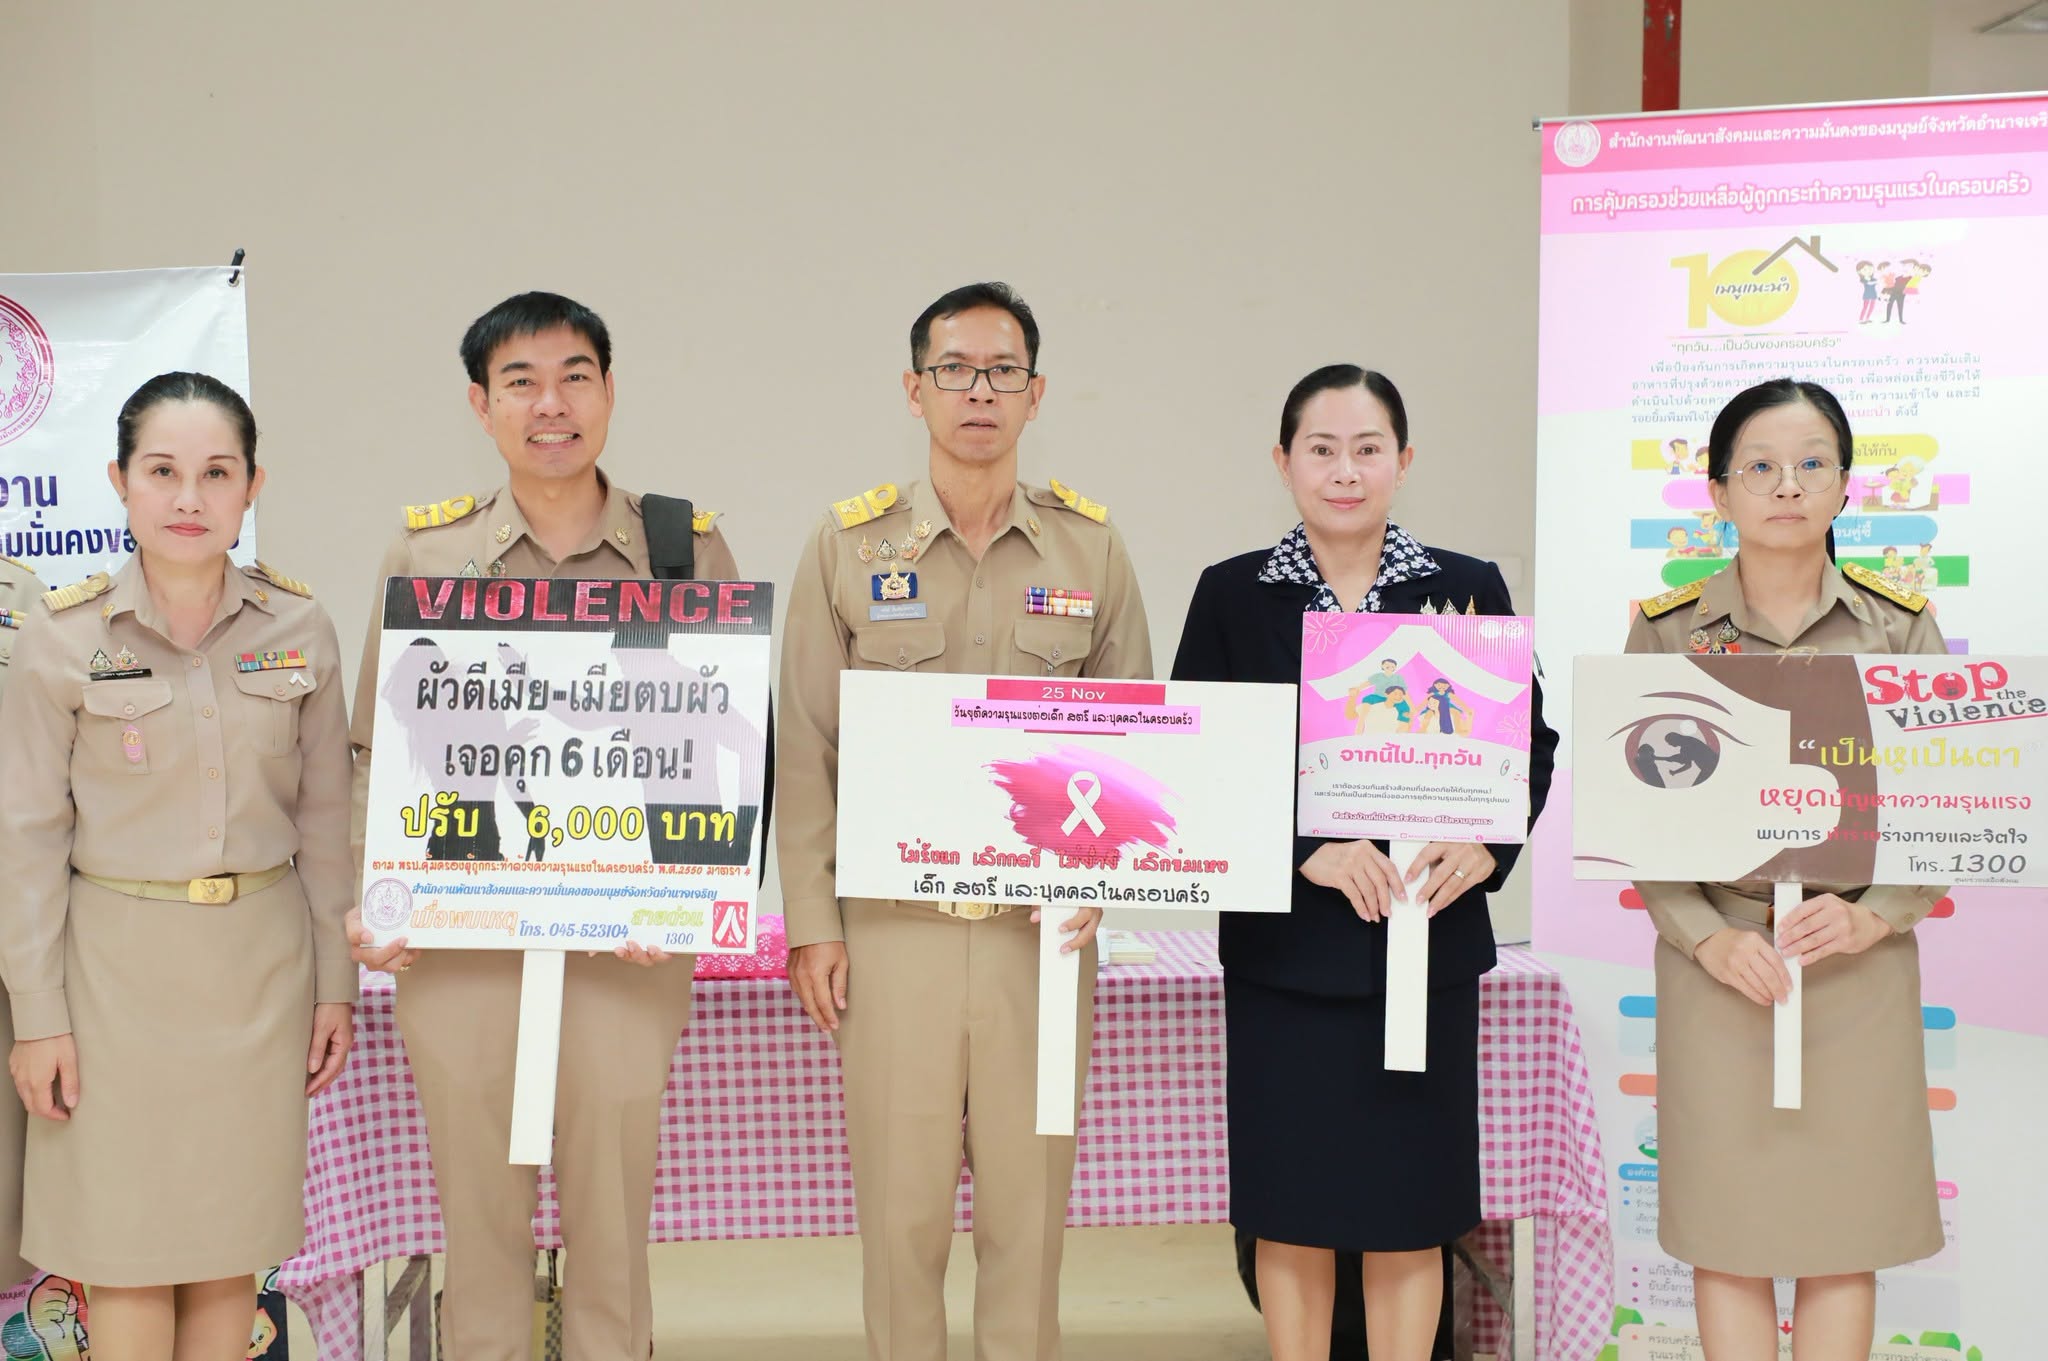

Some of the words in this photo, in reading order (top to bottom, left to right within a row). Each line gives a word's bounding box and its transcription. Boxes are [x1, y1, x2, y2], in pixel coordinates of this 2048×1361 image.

[1609, 112, 2048, 149] สำนักงานพัฒนาสังคมและความมั่นคงของมนุษย์จังหวัดอำนาจเจริ
[1572, 172, 2031, 218] การคุ้มครองช่วยเหลือผู้ถูกกระทำความรุนแรงในครอบครัว
[1715, 276, 1790, 300] เมนูแนะนำ
[412, 579, 758, 625] VIOLENCE
[416, 660, 730, 714] ผัวตีเมีย-เมียตบผัว
[1042, 687, 1065, 699] 25
[1071, 688, 1106, 701] Nov
[1864, 661, 2009, 705] Stop
[1996, 689, 2027, 700] the
[954, 704, 1064, 722] วันยุติความรุนแรงต่อเด็ก
[1067, 709, 1089, 723] สตรี
[1092, 710, 1193, 727] และบุคคลในครอบครัว
[1886, 698, 2047, 728] Violence
[444, 739, 551, 793] เจอคุก
[560, 737, 584, 777] 6
[593, 728, 693, 780] เดือน!
[1339, 742, 1483, 771] จากนี้ไป..ทุกวัน
[1760, 787, 2032, 814] หยุดปัญหาความรุนแรง
[401, 790, 480, 838] ปรับ
[526, 804, 645, 845] 6,000
[661, 808, 736, 843] บาท
[1757, 827, 1821, 841] พบการ
[372, 860, 394, 872] ตาม
[706, 865, 741, 877] มาตรา
[897, 838, 961, 865] ไม่รังแก
[972, 843, 1042, 868] เลิกกดขี่
[1133, 848, 1229, 873] เลิกข่มเหง
[914, 873, 945, 894] เด็ก
[953, 876, 998, 896] สตรี
[1005, 880, 1210, 903] และบุคคลในครอบครัว
[410, 899, 518, 936] เมื่อพบเหตุ
[519, 920, 545, 937] โทร.
[549, 921, 630, 939] 045-523104
[631, 905, 704, 927] สายด่วน
[664, 932, 694, 945] 1300
